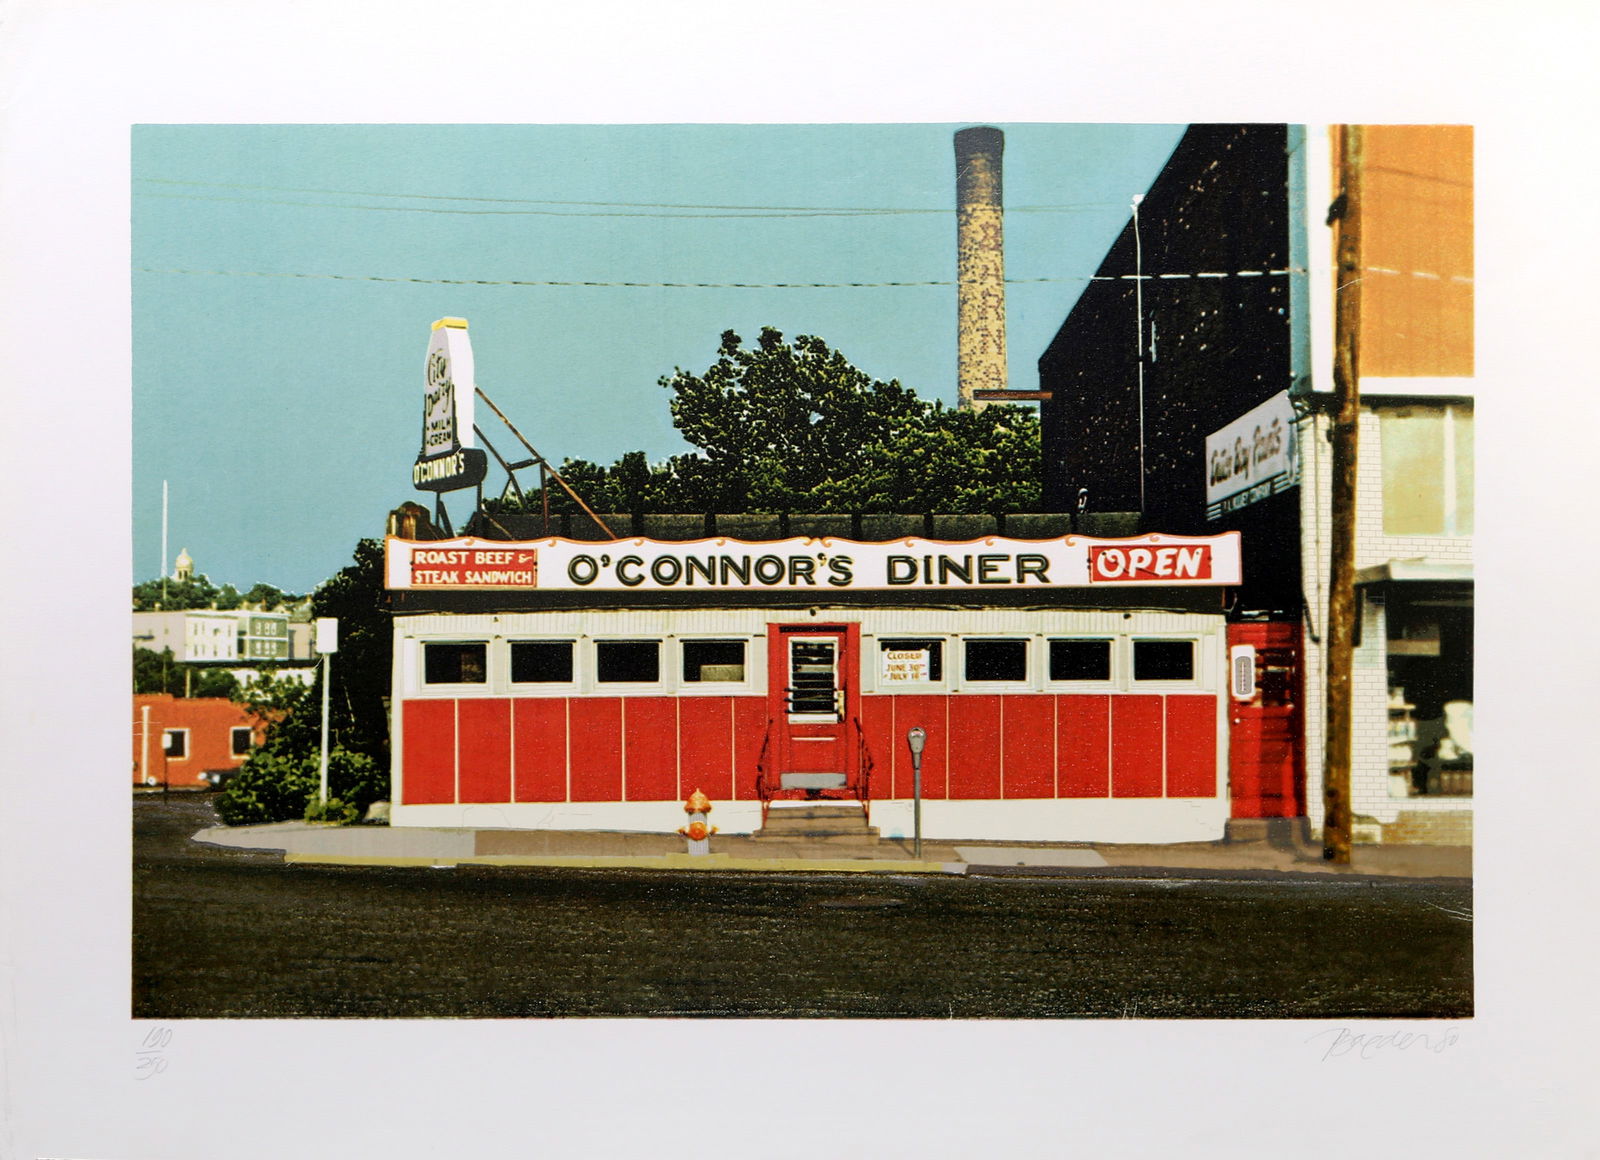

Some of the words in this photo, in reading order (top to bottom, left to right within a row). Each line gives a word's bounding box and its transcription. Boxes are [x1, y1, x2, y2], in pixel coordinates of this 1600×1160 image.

[413, 453, 465, 484] O'CONNOR'S
[415, 551, 469, 564] ROAST
[475, 552, 515, 565] BEEF
[518, 554, 533, 564] &
[1096, 547, 1203, 579] OPEN
[415, 570, 459, 584] STEAK
[465, 571, 532, 584] SANDWICH
[567, 553, 854, 587] O'CONNOR'S
[886, 554, 1051, 585] DINER
[887, 652, 922, 660] CLOSED
[887, 663, 905, 672] JUNE
